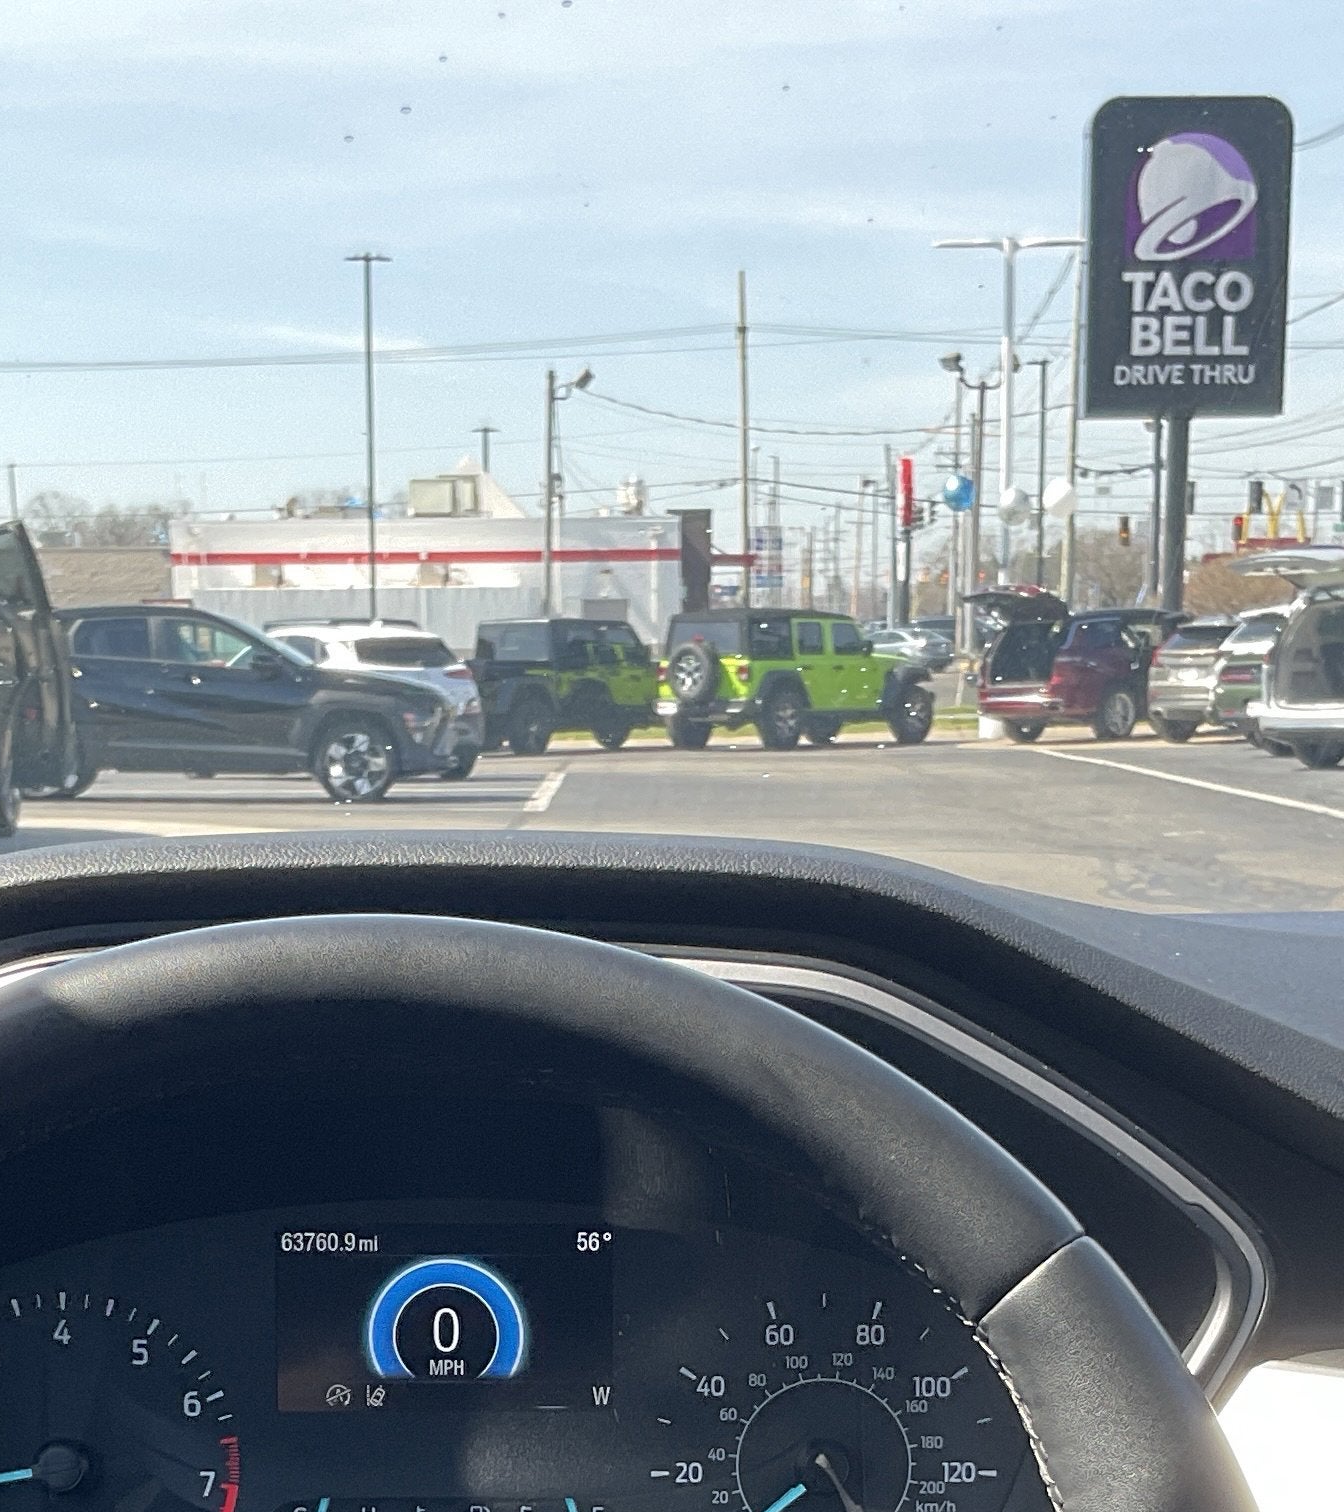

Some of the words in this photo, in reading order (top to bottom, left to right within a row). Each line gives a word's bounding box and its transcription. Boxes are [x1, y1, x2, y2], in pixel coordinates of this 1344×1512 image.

[1122, 271, 1254, 312] TACO
[1129, 316, 1249, 356] BELL
[1114, 365, 1184, 386] DRIVE
[1191, 364, 1255, 384] THRU
[53, 1319, 71, 1344] 4
[433, 1308, 459, 1352] 0
[766, 1325, 794, 1346] 60
[856, 1324, 884, 1346] 80
[132, 1339, 148, 1365] 5
[832, 1353, 852, 1366] 120
[429, 1360, 464, 1376] MPH
[785, 1356, 808, 1369] 100
[749, 1374, 767, 1387] 80
[872, 1368, 894, 1380] 140
[593, 1386, 610, 1405] W
[696, 1375, 725, 1397] 40
[913, 1376, 950, 1397] 100
[183, 1391, 201, 1416] 6
[905, 1400, 928, 1413] 160
[720, 1408, 737, 1420] 60
[921, 1436, 943, 1449] 180
[708, 1448, 725, 1461] 40
[675, 1462, 702, 1482] 20
[942, 1462, 976, 1483] 120
[199, 1471, 216, 1497] 7
[919, 1481, 945, 1494] 200
[712, 1491, 728, 1504] 20
